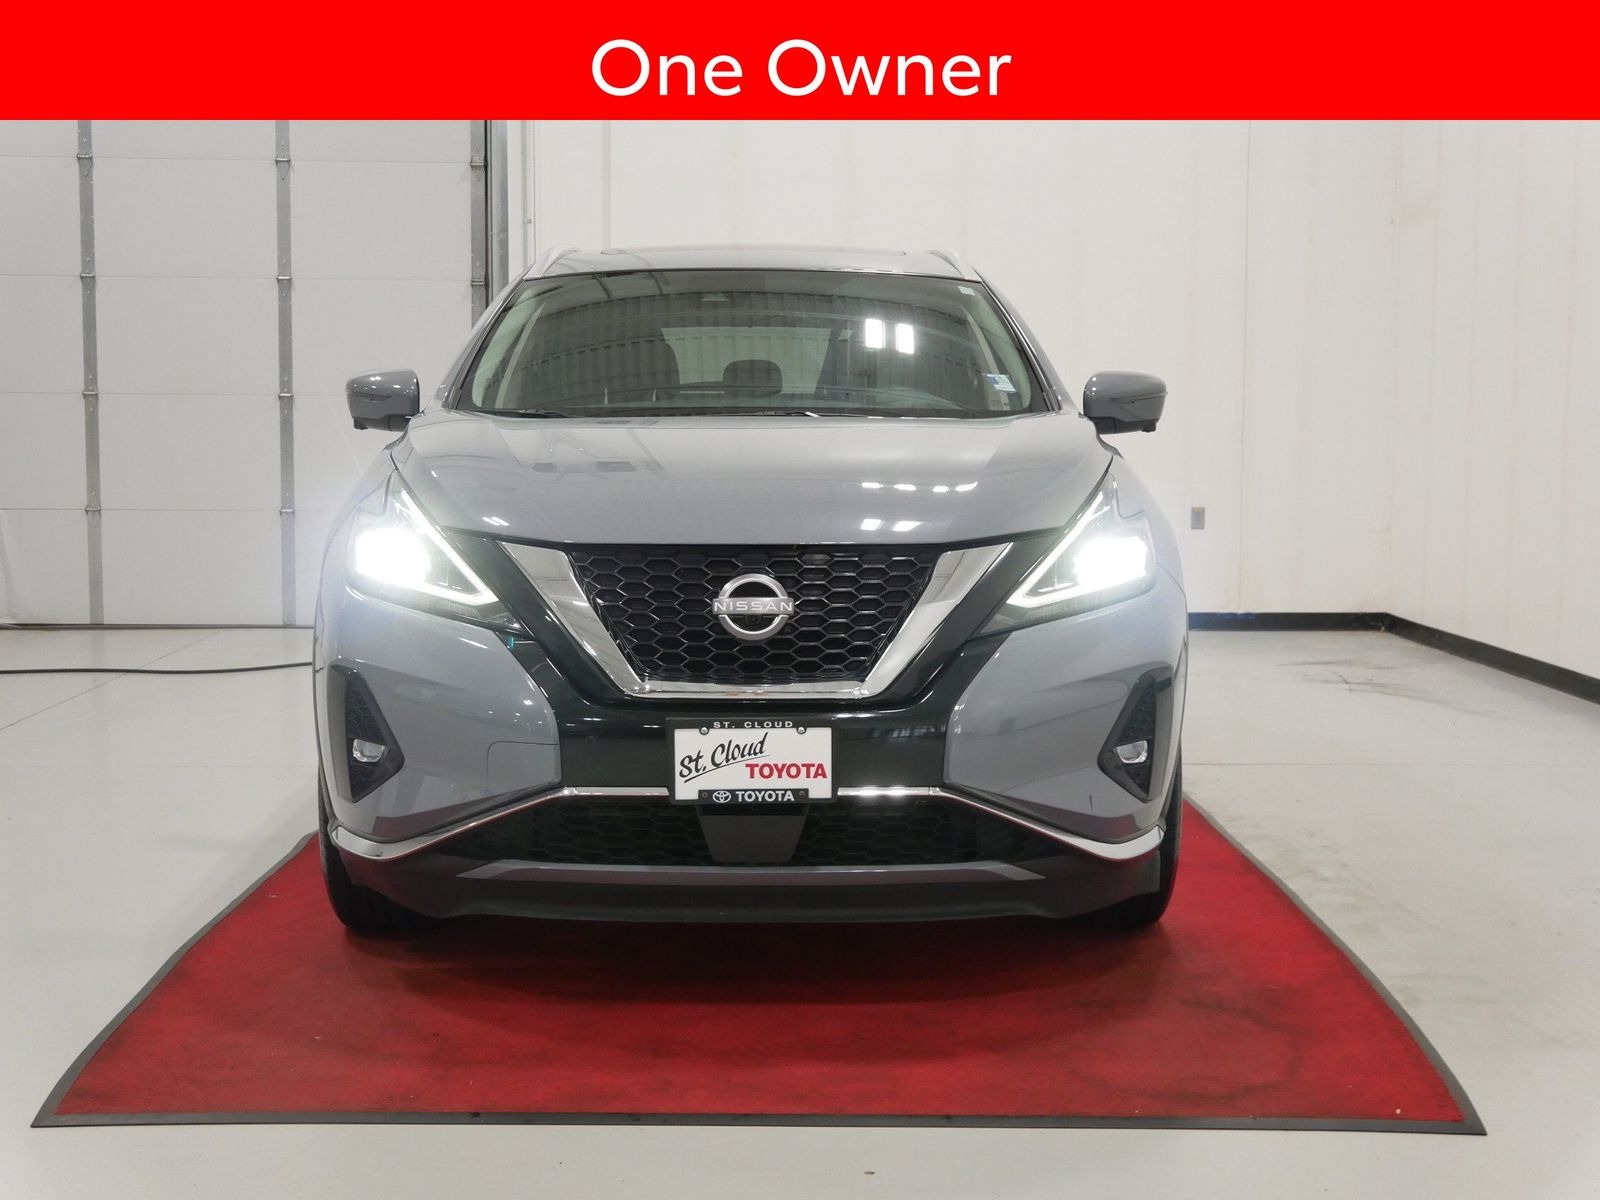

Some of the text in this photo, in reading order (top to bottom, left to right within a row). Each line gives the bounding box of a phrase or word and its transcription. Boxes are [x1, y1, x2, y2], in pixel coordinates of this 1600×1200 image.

[714, 601, 793, 612] NISSAN
[713, 721, 735, 729] ST.
[679, 732, 769, 778] St. Cloud
[745, 763, 828, 779] TOYOTA
[736, 790, 795, 802] TOYOTA
